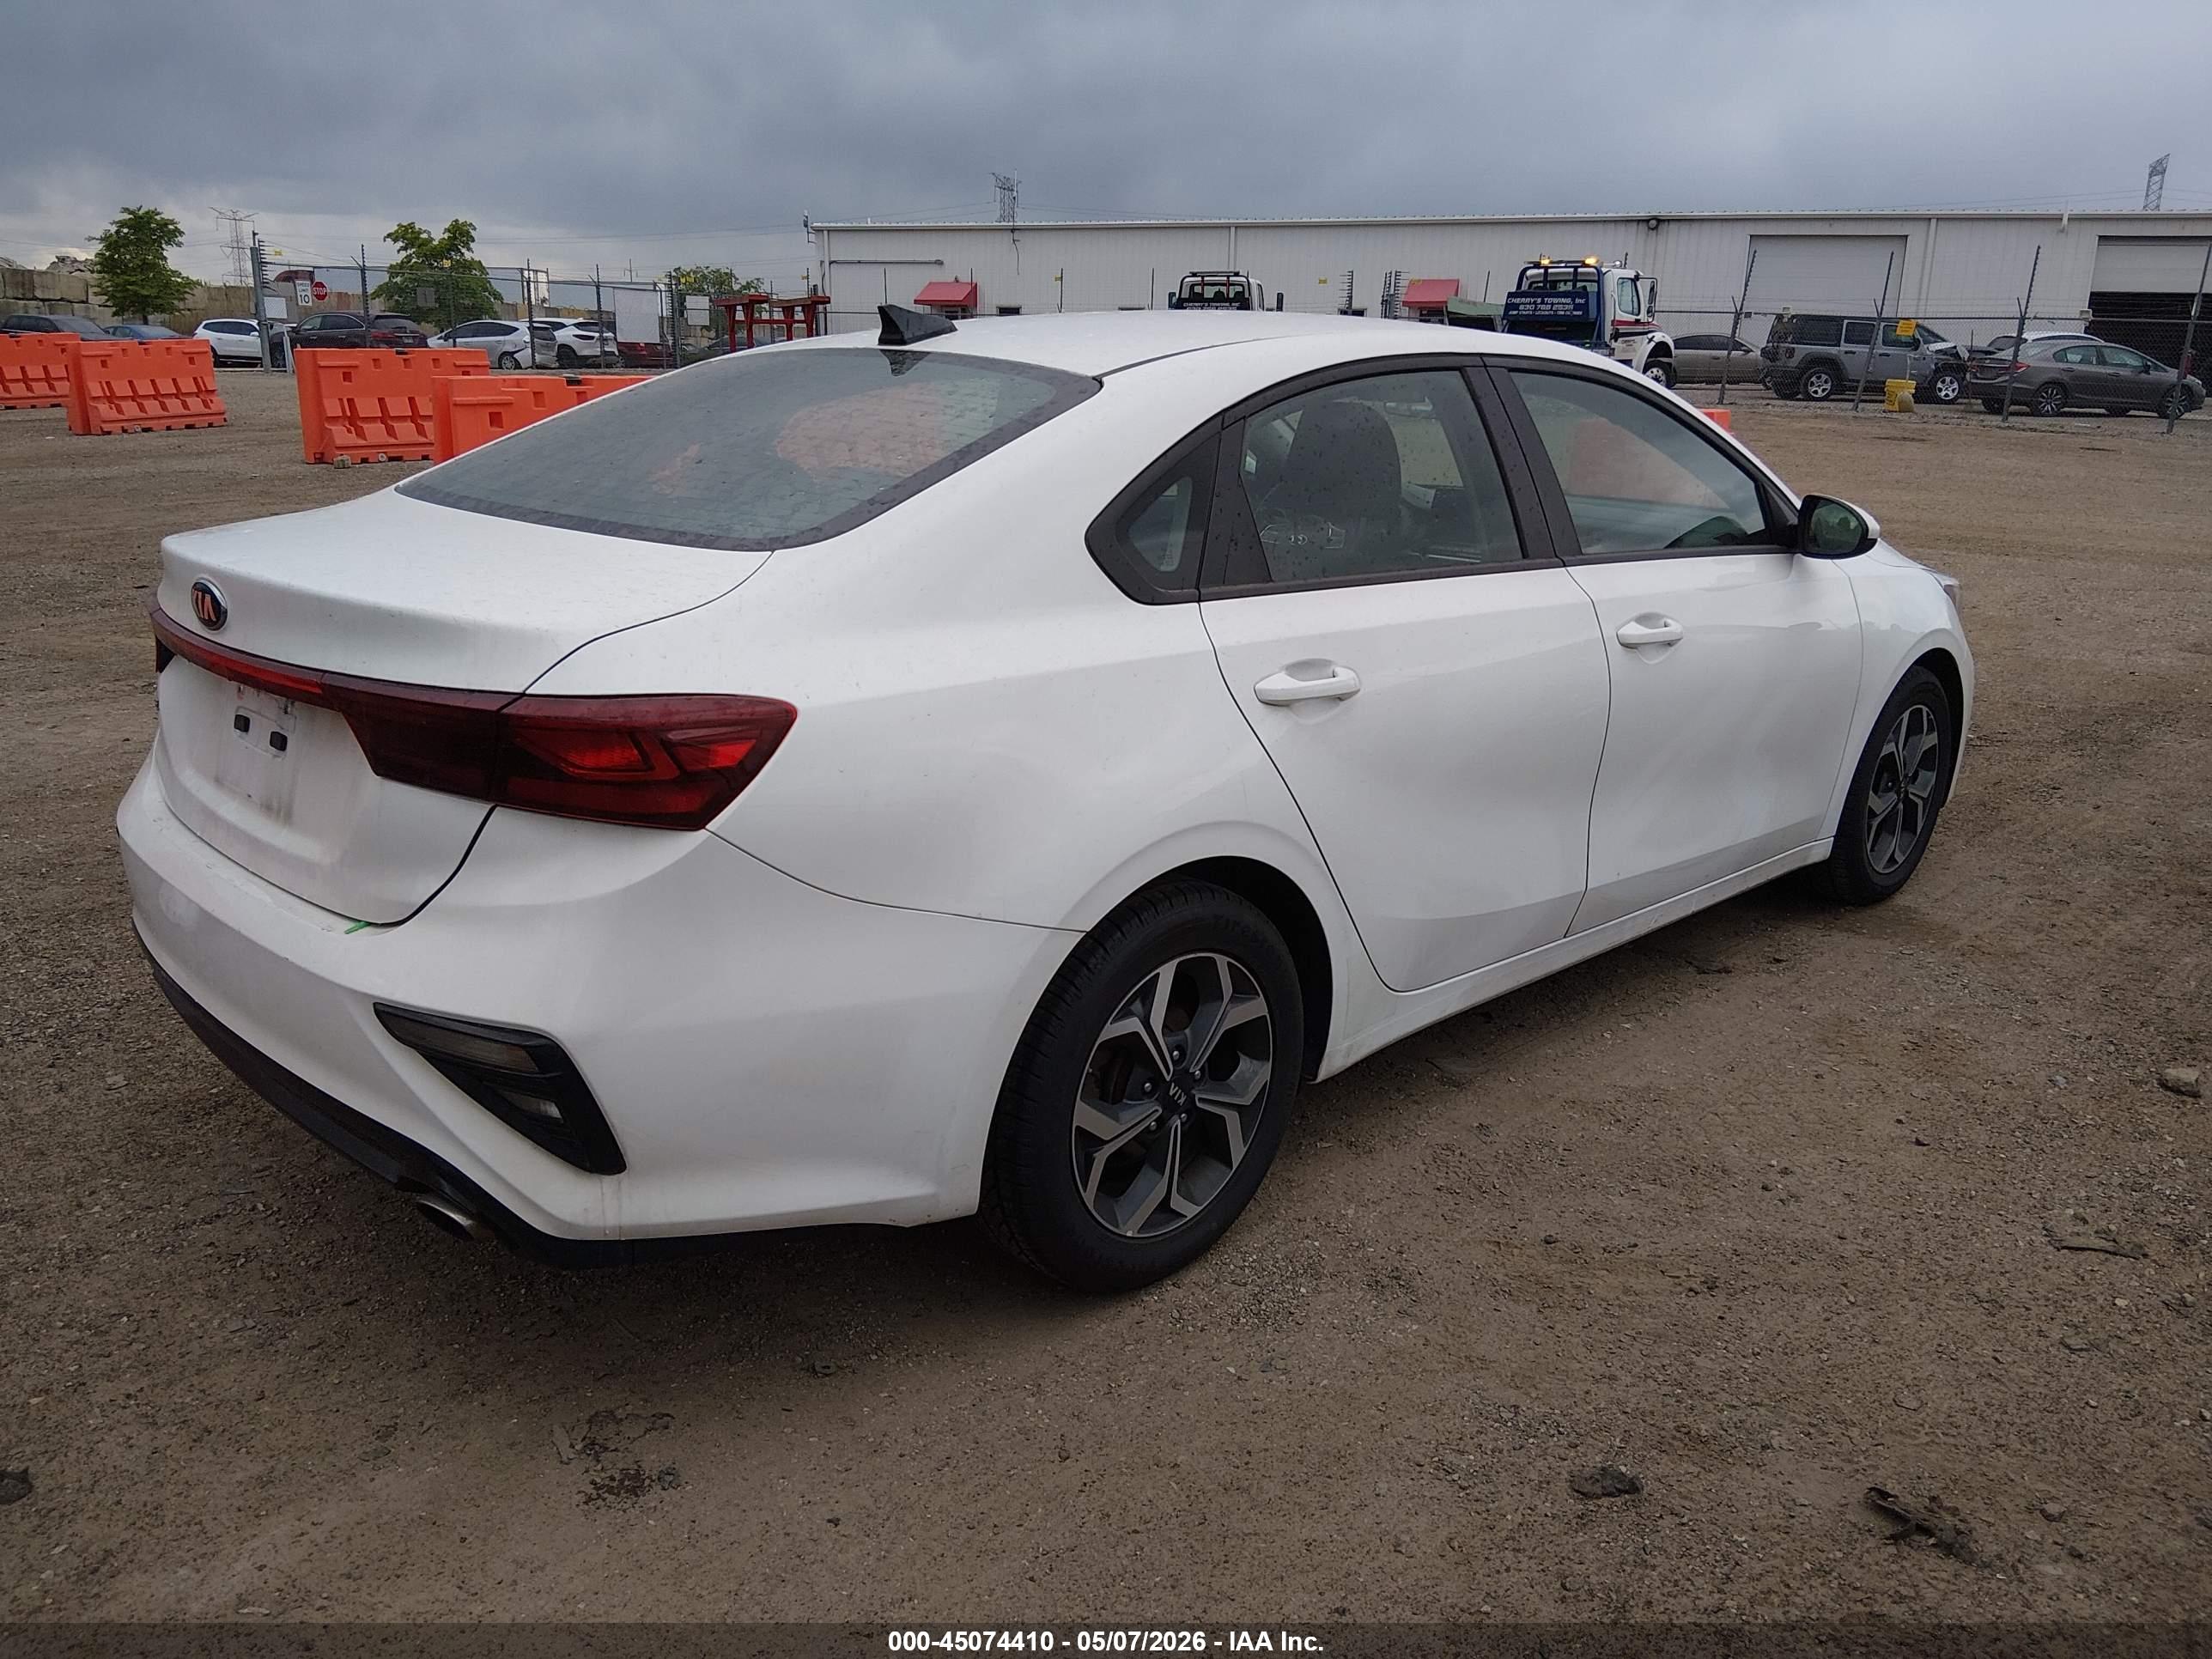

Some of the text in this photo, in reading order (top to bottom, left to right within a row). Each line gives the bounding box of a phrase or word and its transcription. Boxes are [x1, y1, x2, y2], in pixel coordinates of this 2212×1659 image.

[313, 287, 327, 295] STOP
[299, 294, 310, 304] 10
[1168, 1082, 1188, 1107] KIA
